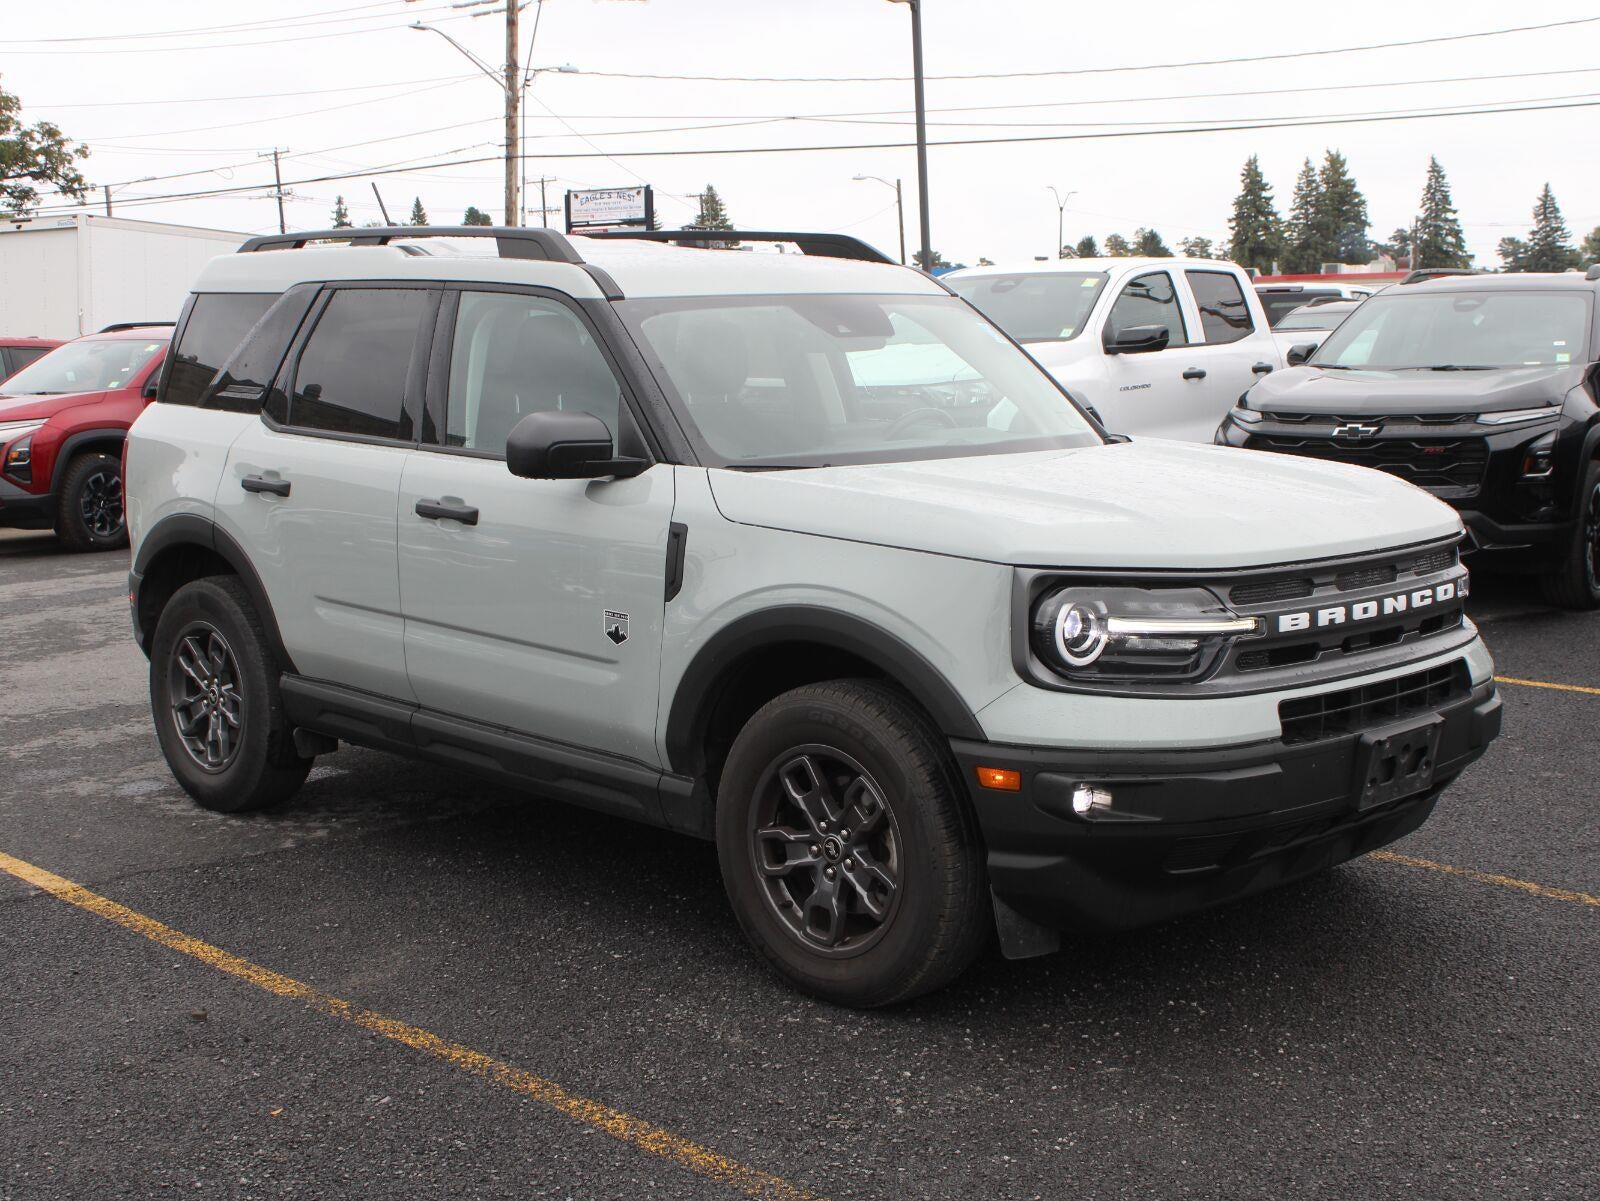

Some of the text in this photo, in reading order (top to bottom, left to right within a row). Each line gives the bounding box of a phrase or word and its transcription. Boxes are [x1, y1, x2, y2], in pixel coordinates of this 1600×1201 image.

[580, 191, 612, 206] EAGLE'S
[616, 191, 636, 203] NEST
[1278, 583, 1455, 633] BRONCO
